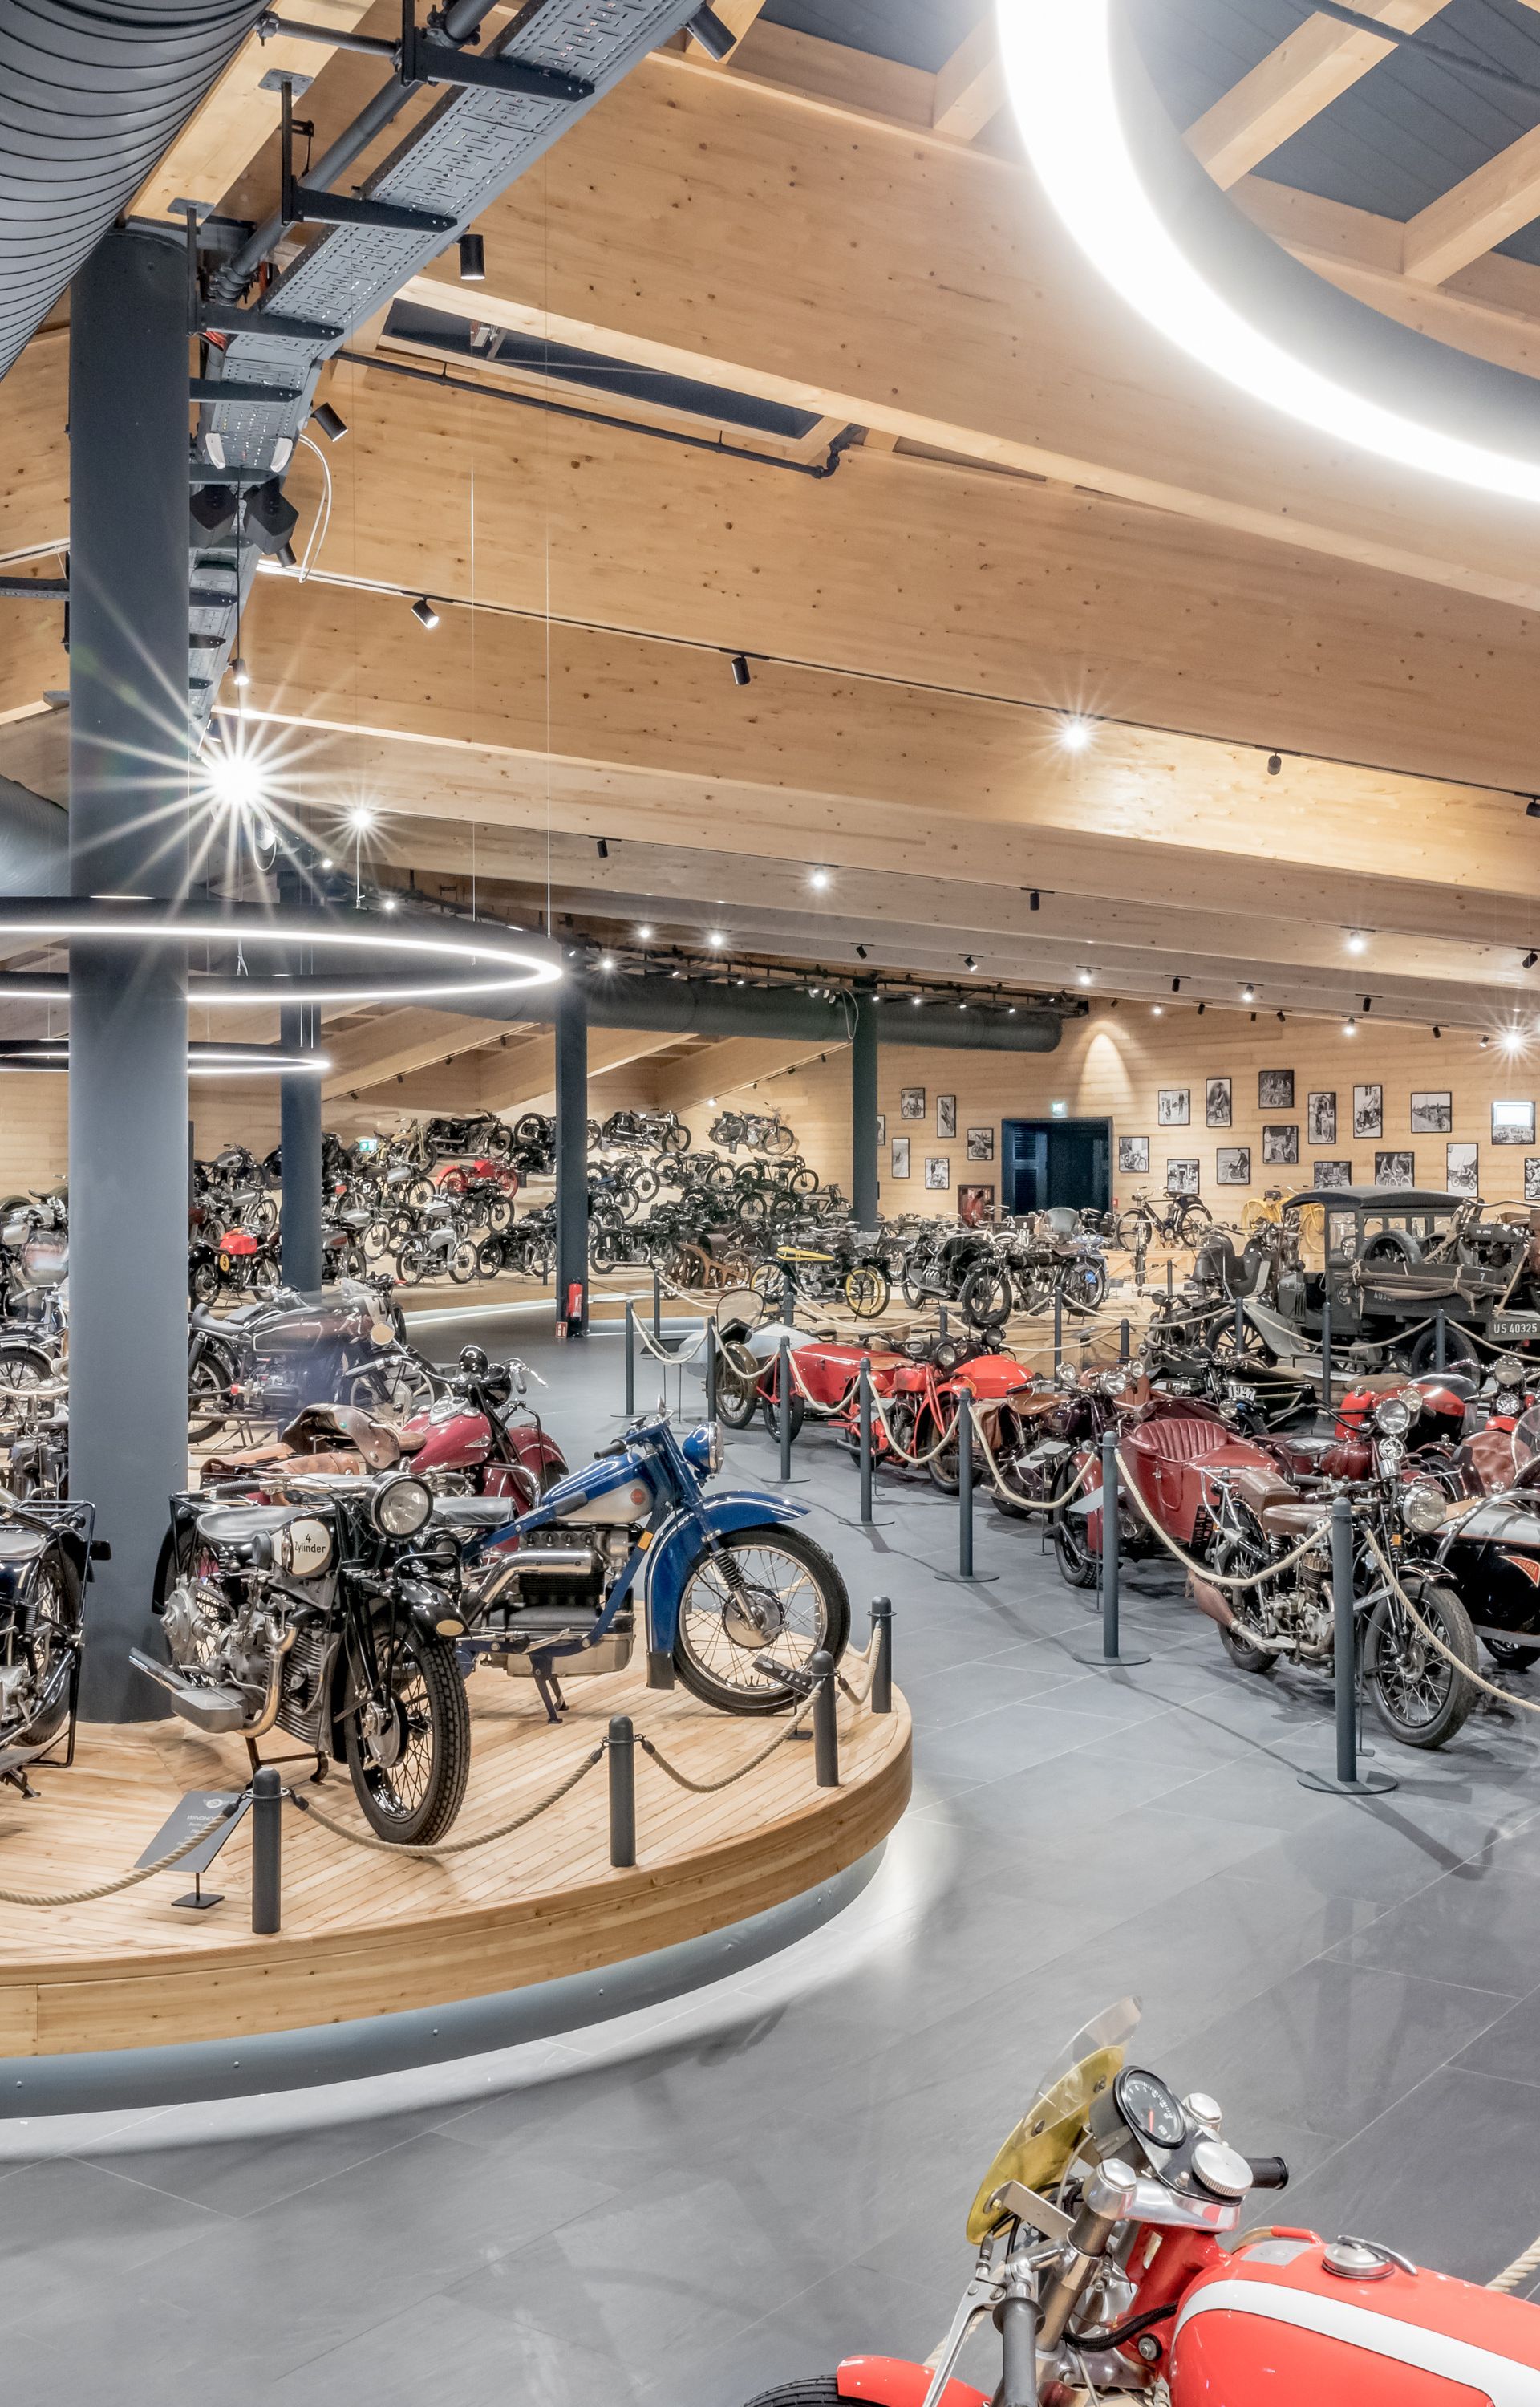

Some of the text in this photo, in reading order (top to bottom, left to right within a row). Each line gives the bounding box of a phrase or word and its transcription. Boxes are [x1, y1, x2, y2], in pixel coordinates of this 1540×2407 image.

[363, 1183, 372, 1194] 57
[1480, 1273, 1485, 1283] 7
[1493, 1323, 1538, 1333] US 40325
[305, 1533, 312, 1543] 4
[294, 1541, 326, 1553] Zylinder
